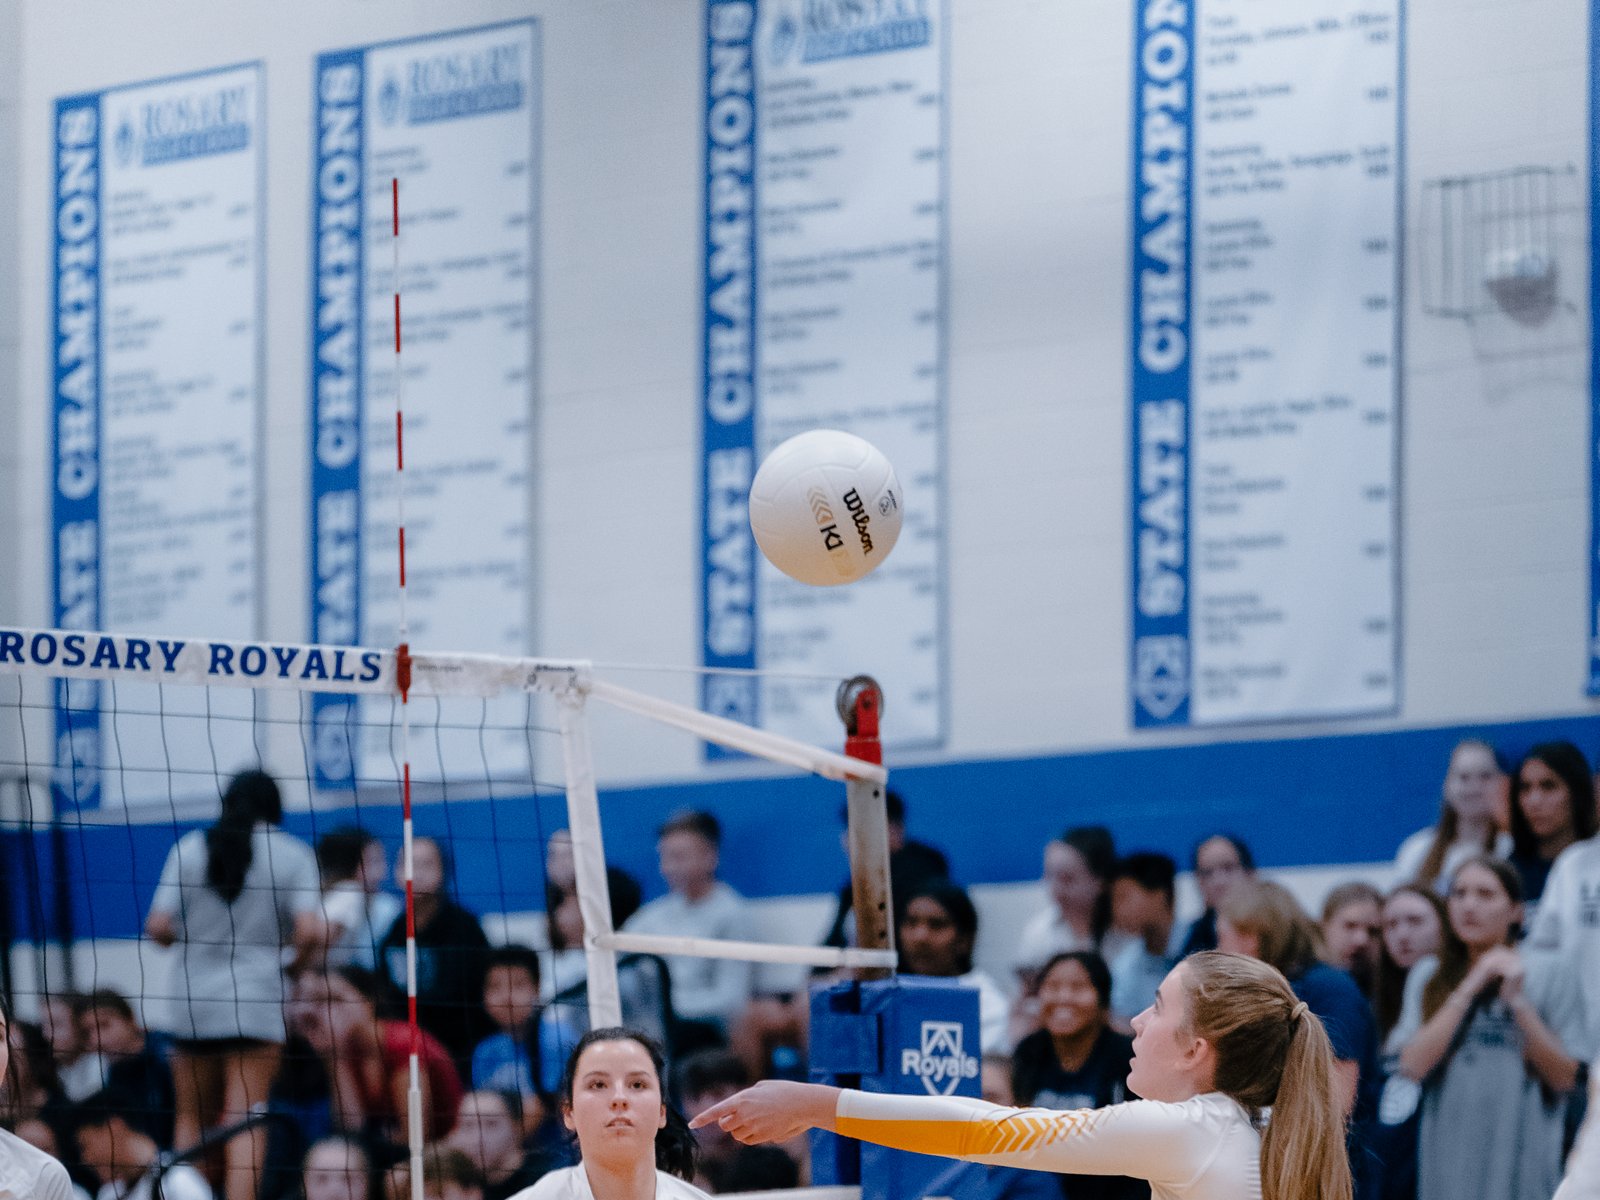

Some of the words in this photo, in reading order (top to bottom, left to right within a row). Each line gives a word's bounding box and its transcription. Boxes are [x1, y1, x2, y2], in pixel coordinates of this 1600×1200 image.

[59, 105, 98, 499] CHAMPIONS
[319, 62, 360, 469] CHAMPIONS
[709, 1, 753, 424] CHAMPIONS
[708, 448, 753, 656] STATE
[820, 523, 844, 551] K1
[843, 487, 874, 557] Wilson
[1138, 399, 1184, 617] STATE
[0, 630, 186, 674] ROSARY
[208, 642, 381, 682] ROYALS
[902, 1048, 980, 1083] Royals
